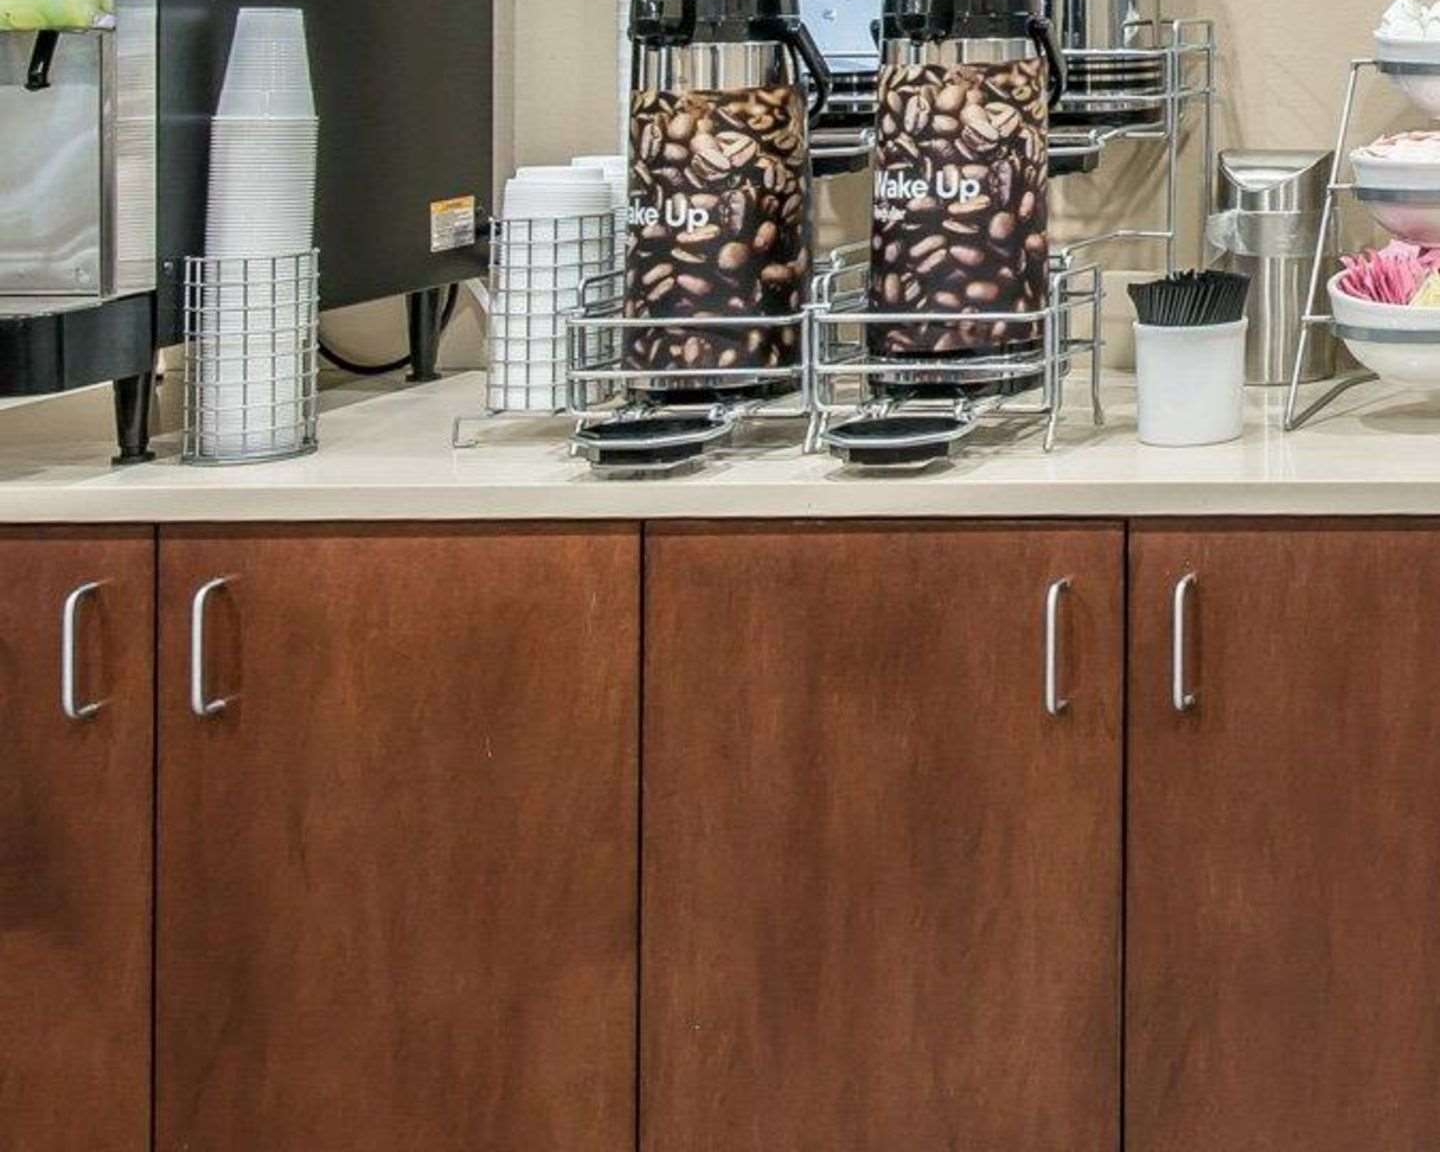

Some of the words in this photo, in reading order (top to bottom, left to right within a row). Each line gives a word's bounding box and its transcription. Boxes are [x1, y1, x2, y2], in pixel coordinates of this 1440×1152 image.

[936, 170, 980, 203] Up
[627, 198, 660, 225] ake
[665, 199, 709, 233] Up
